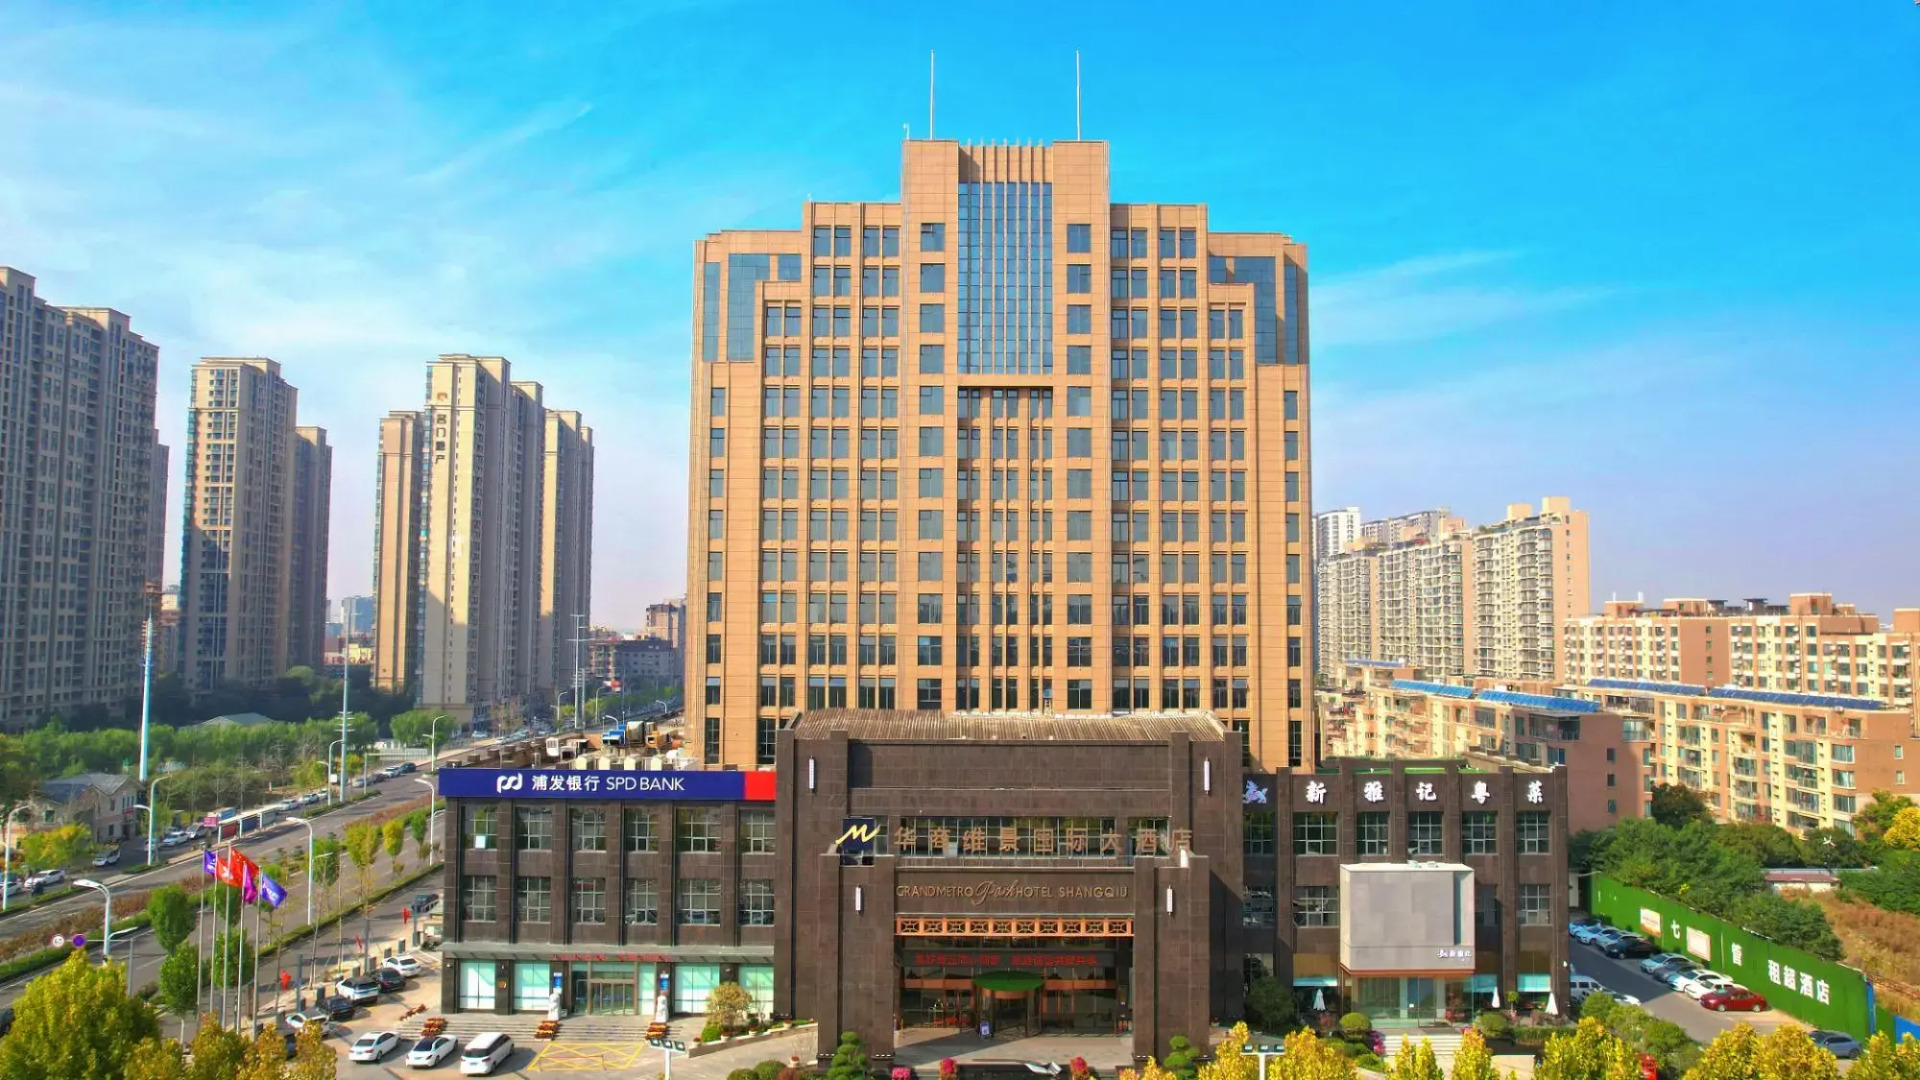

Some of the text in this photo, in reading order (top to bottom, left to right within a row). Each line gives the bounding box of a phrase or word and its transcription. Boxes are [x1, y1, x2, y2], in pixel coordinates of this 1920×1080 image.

[532, 775, 685, 792] 浦发银行 SPD BANK
[1305, 780, 1544, 805] 新雅记粤菜
[893, 826, 1193, 854] 华商维景国际大酒店
[1017, 886, 1053, 898] HOTEL
[1059, 886, 1129, 898] SHANGQIU
